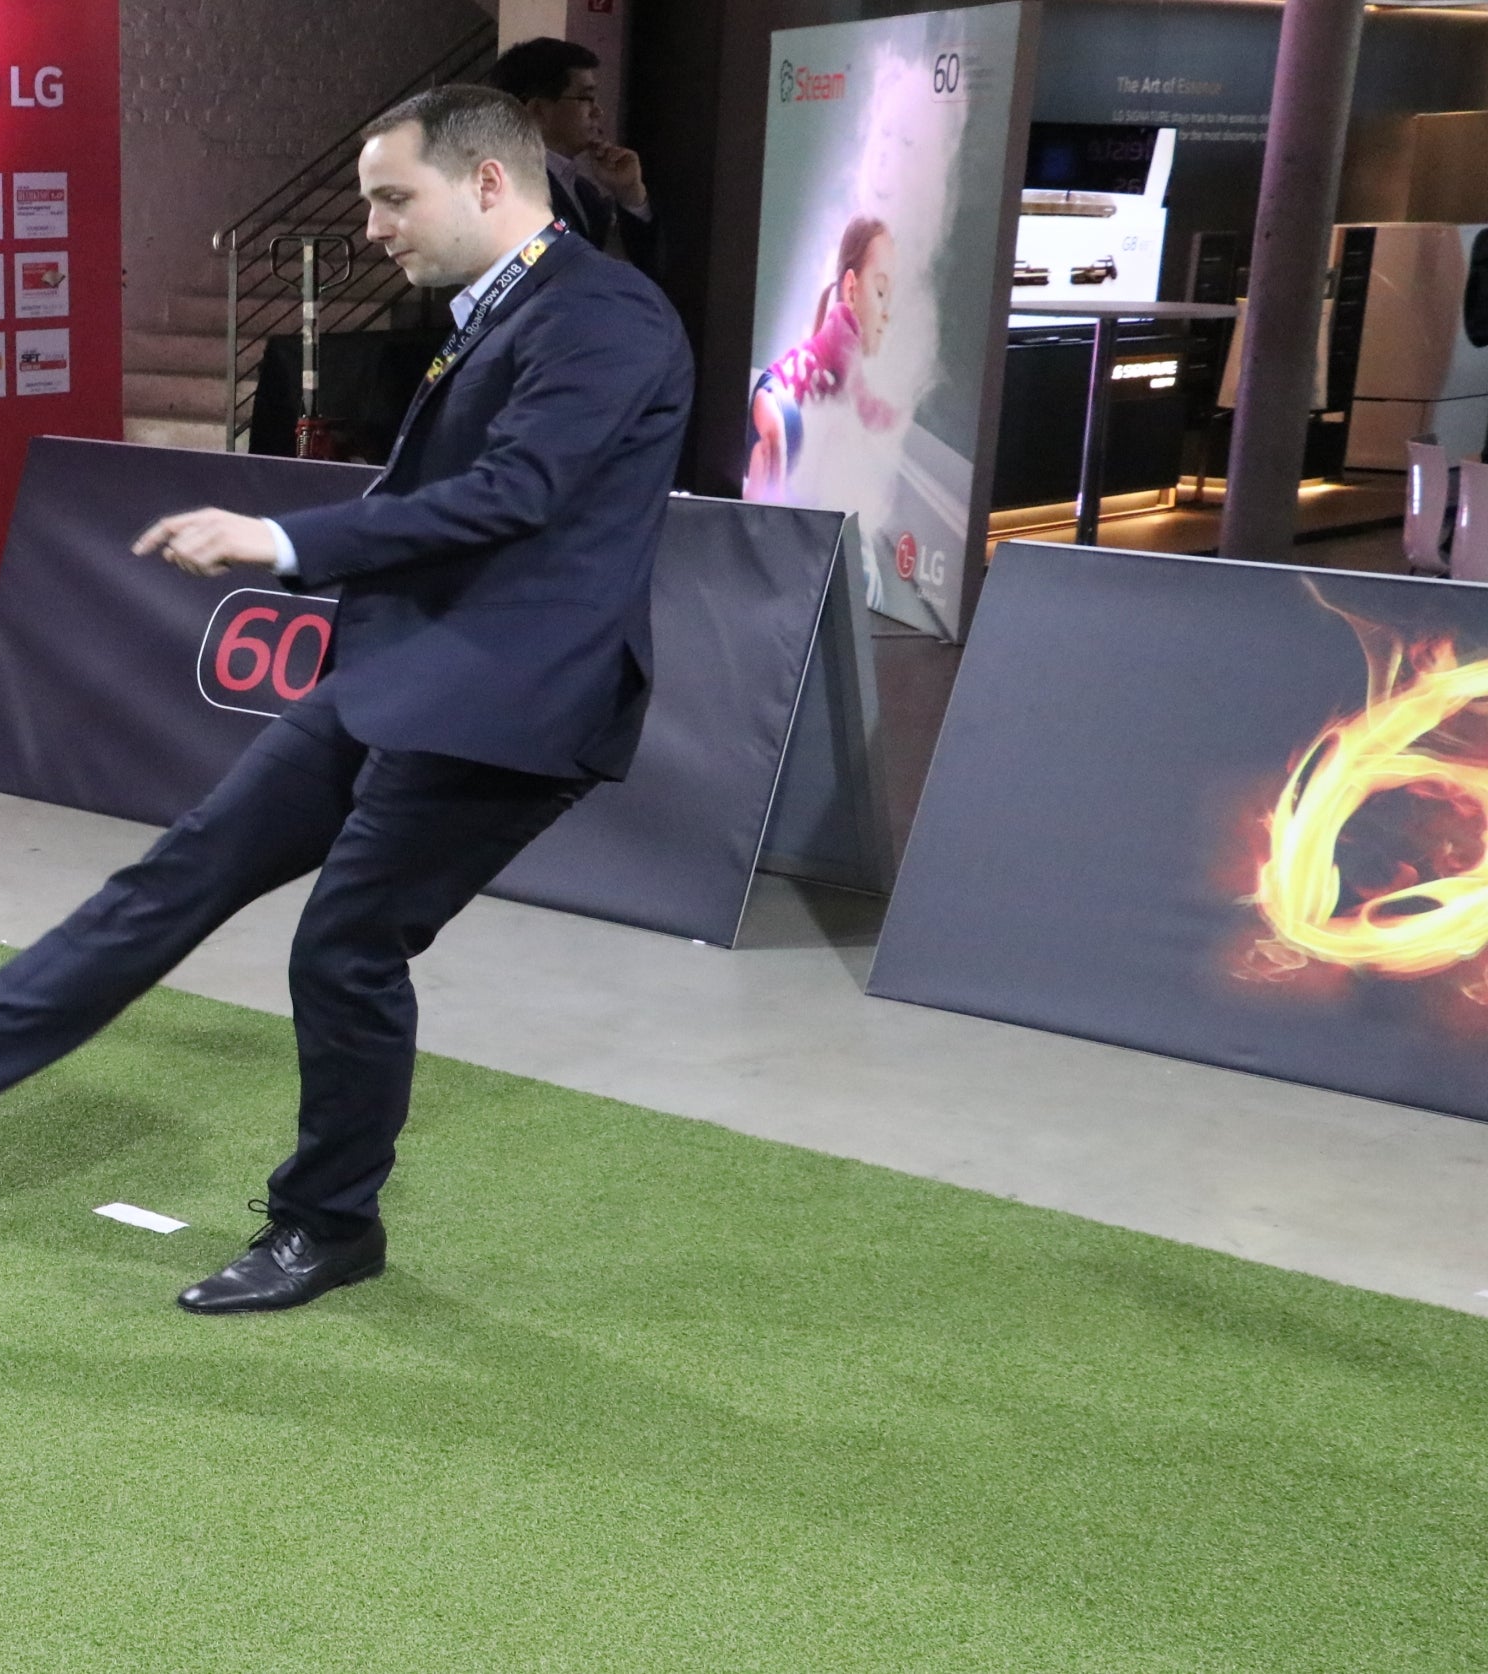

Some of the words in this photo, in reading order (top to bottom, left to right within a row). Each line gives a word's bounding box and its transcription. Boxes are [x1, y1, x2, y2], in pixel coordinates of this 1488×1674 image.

[10, 66, 64, 108] LG
[795, 66, 845, 101] Steam
[933, 53, 960, 94] 60
[1116, 76, 1139, 94] The
[1140, 76, 1162, 94] Art
[1162, 76, 1177, 94] of
[466, 286, 500, 336] Roadshow
[497, 263, 523, 289] 2018
[919, 545, 946, 586] LG
[215, 606, 332, 701] 60
